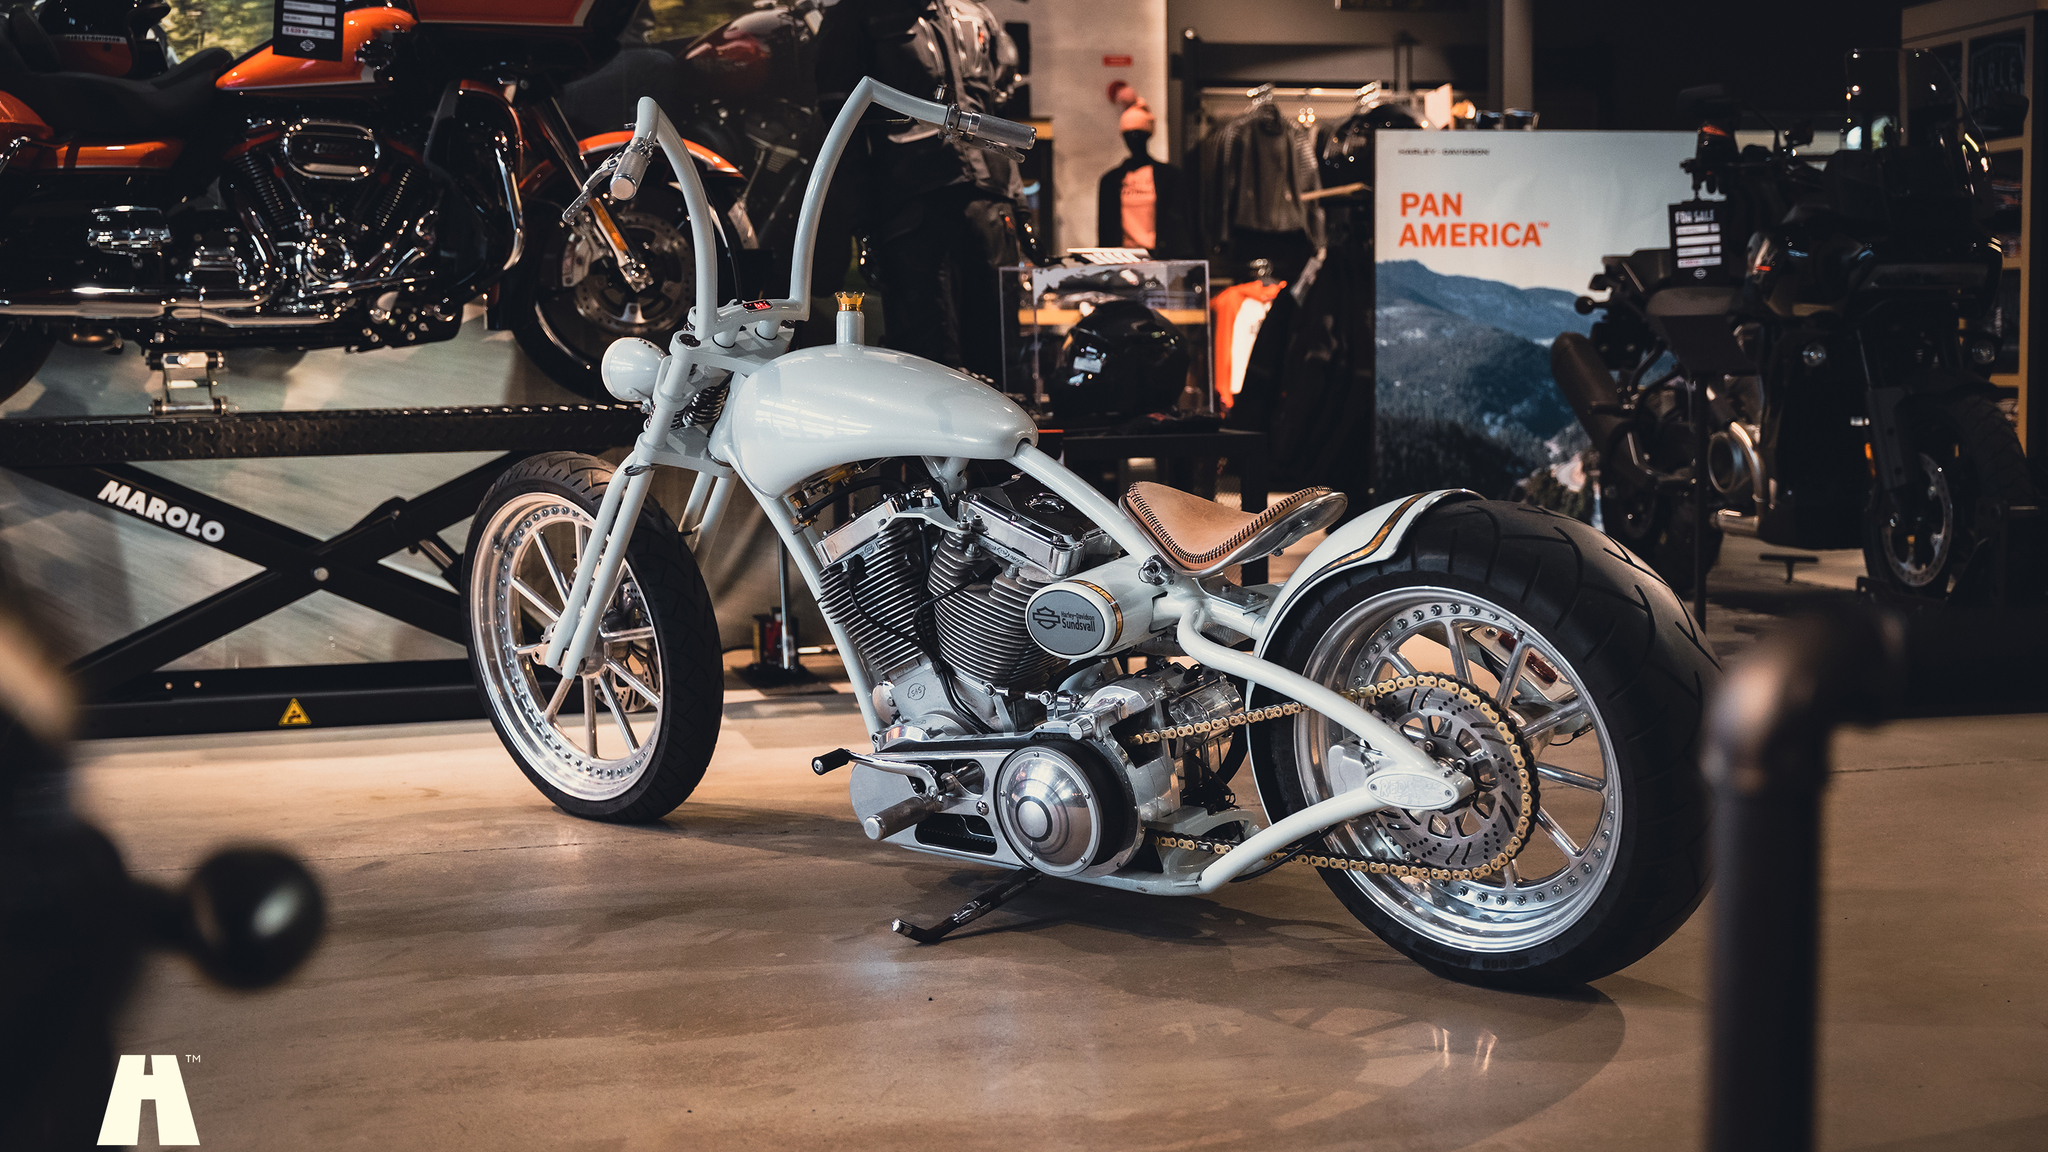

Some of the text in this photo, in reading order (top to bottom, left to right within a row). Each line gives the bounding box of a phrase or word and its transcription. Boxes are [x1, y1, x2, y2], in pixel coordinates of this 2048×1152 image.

[1400, 192, 1463, 217] PAN
[97, 480, 226, 543] MAROLO
[1062, 618, 1096, 632] Sundsvall
